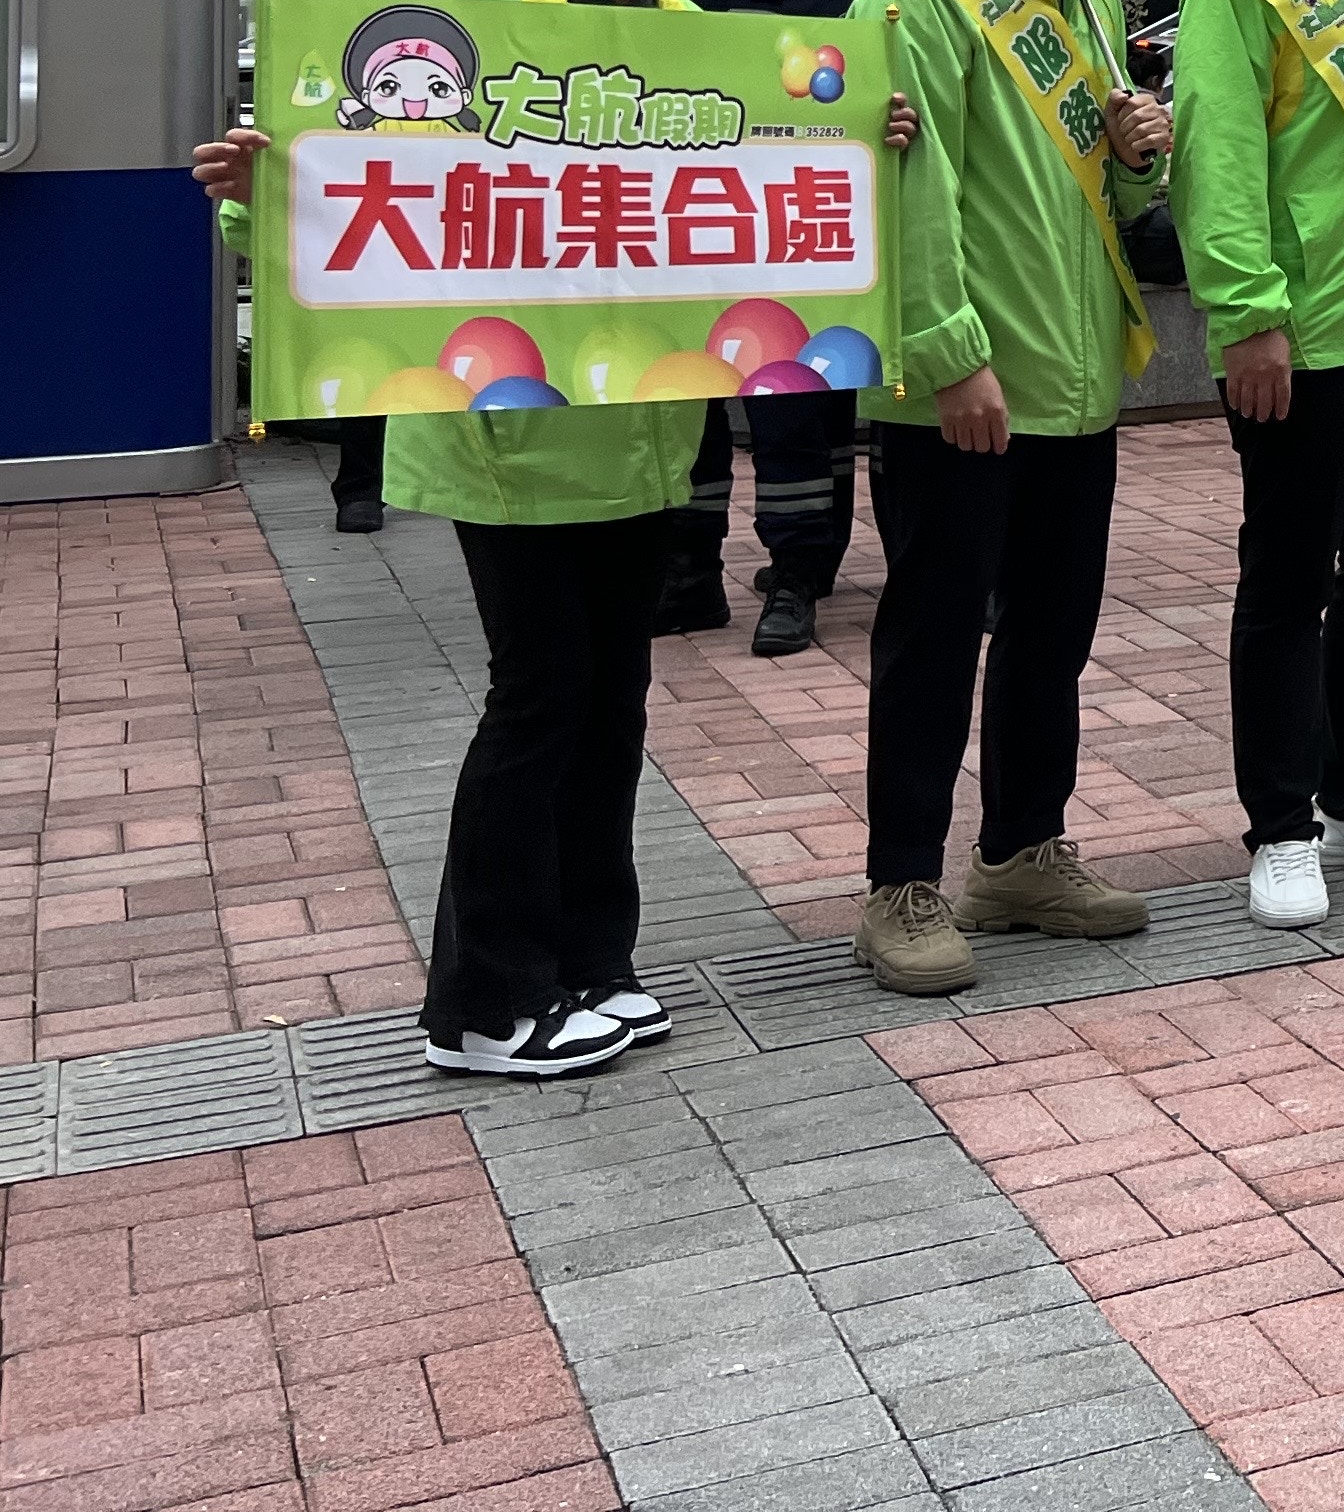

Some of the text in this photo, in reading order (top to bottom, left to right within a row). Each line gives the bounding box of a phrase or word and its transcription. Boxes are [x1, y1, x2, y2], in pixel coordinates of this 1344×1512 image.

[396, 41, 430, 58] 大航
[484, 62, 745, 150] 大航假期
[806, 126, 845, 138] 352829
[323, 160, 856, 272] 大航集合處
